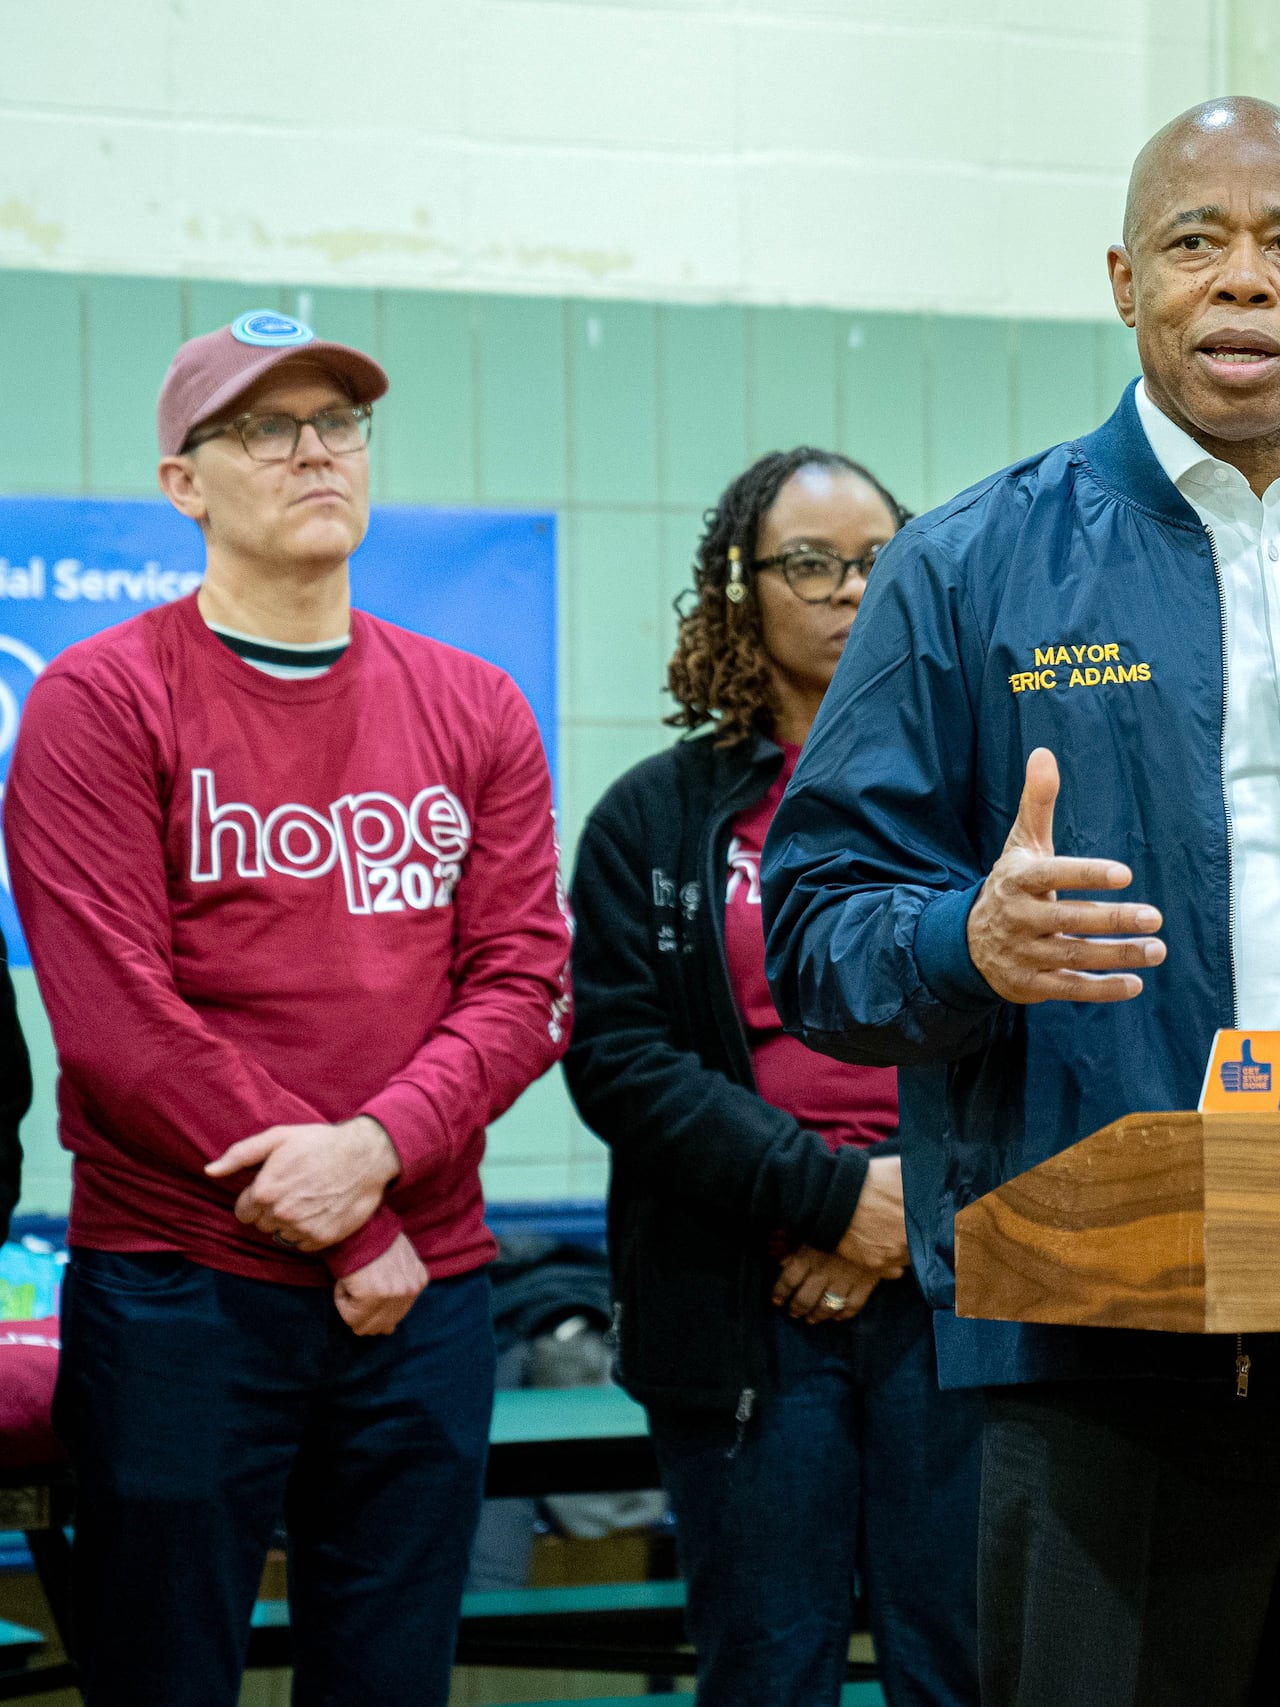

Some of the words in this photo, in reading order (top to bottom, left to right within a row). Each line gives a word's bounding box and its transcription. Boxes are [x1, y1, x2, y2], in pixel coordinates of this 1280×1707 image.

[53, 558, 206, 601] Service
[1034, 643, 1120, 667] MAYOR
[1009, 669, 1057, 693] ERIC
[1068, 662, 1152, 688] ADAMS
[191, 767, 471, 915] hope
[368, 862, 462, 913] 202
[1242, 1067, 1260, 1075] GET
